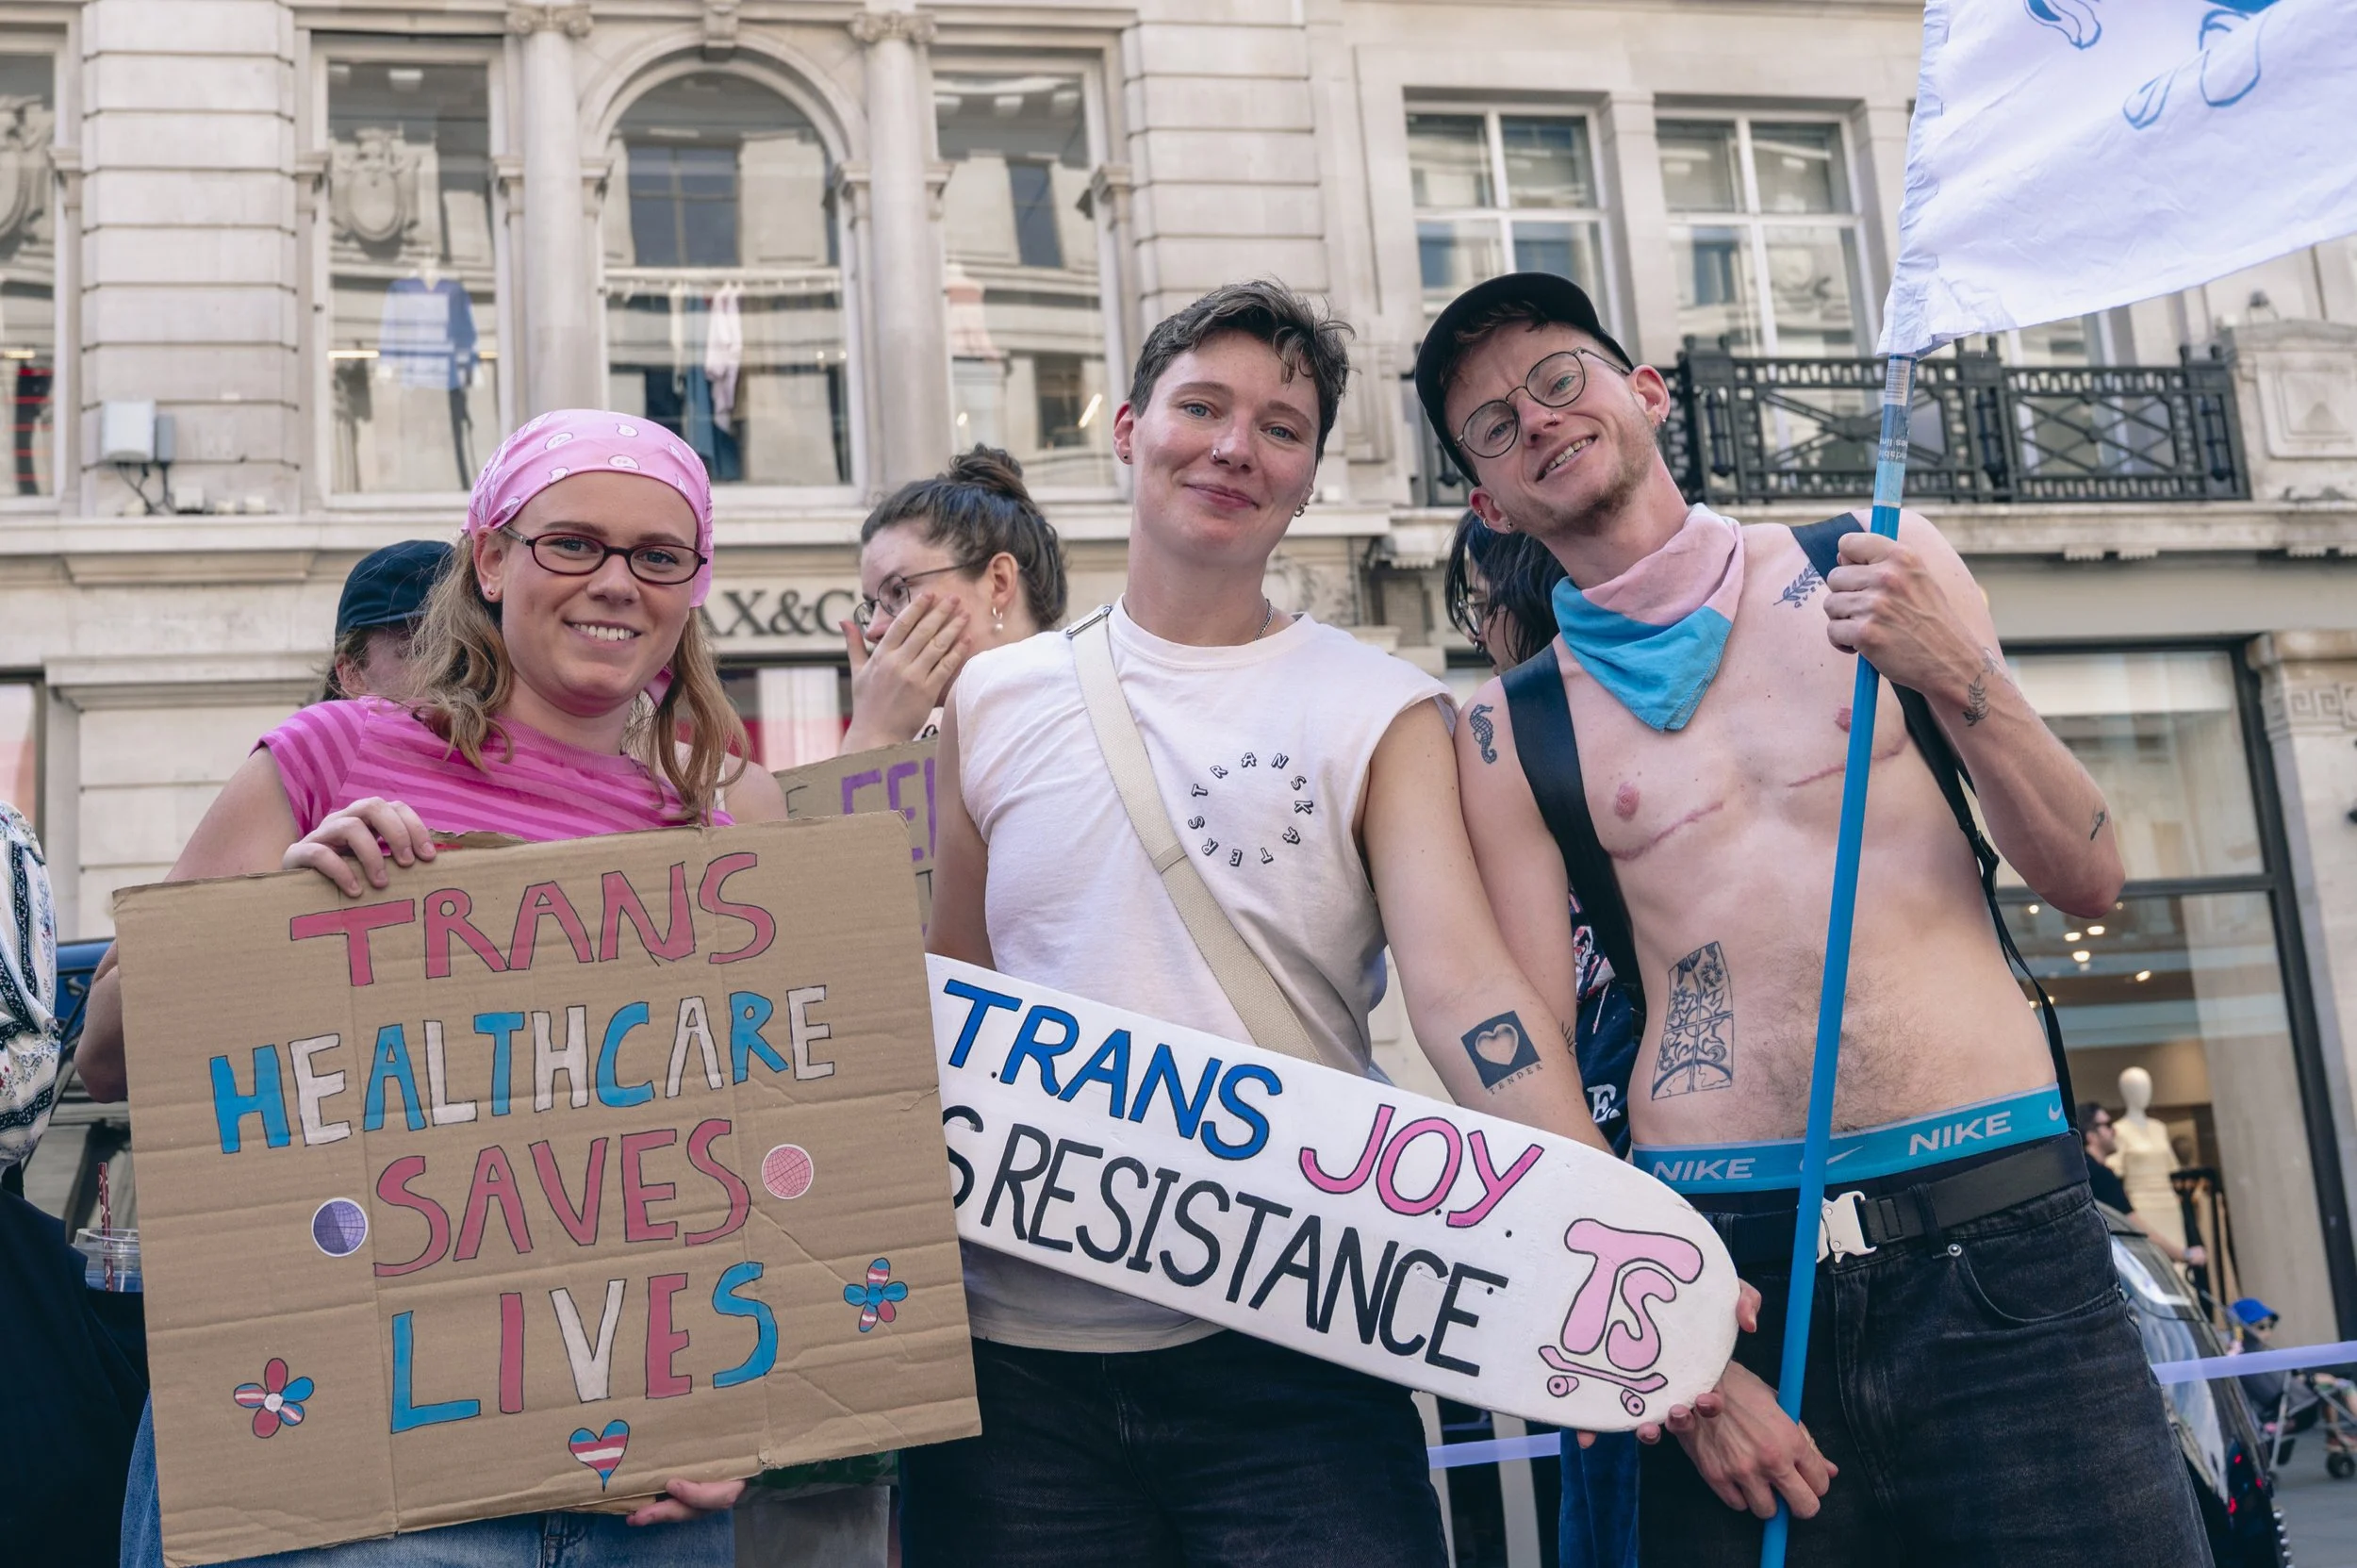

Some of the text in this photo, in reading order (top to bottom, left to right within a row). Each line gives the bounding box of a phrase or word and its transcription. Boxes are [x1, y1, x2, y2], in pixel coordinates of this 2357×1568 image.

[290, 851, 776, 986] TRANS
[209, 984, 835, 1155] HEALTHCARE
[943, 978, 1545, 1228] TRANS JOY
[1488, 1064, 1543, 1096] TENDER
[1907, 1111, 2012, 1156] NIKE
[373, 1119, 751, 1278] SAVES
[1653, 1157, 1755, 1181] NIKE
[981, 1123, 1509, 1378] RESISTANCE
[390, 1261, 779, 1434] LIVES
